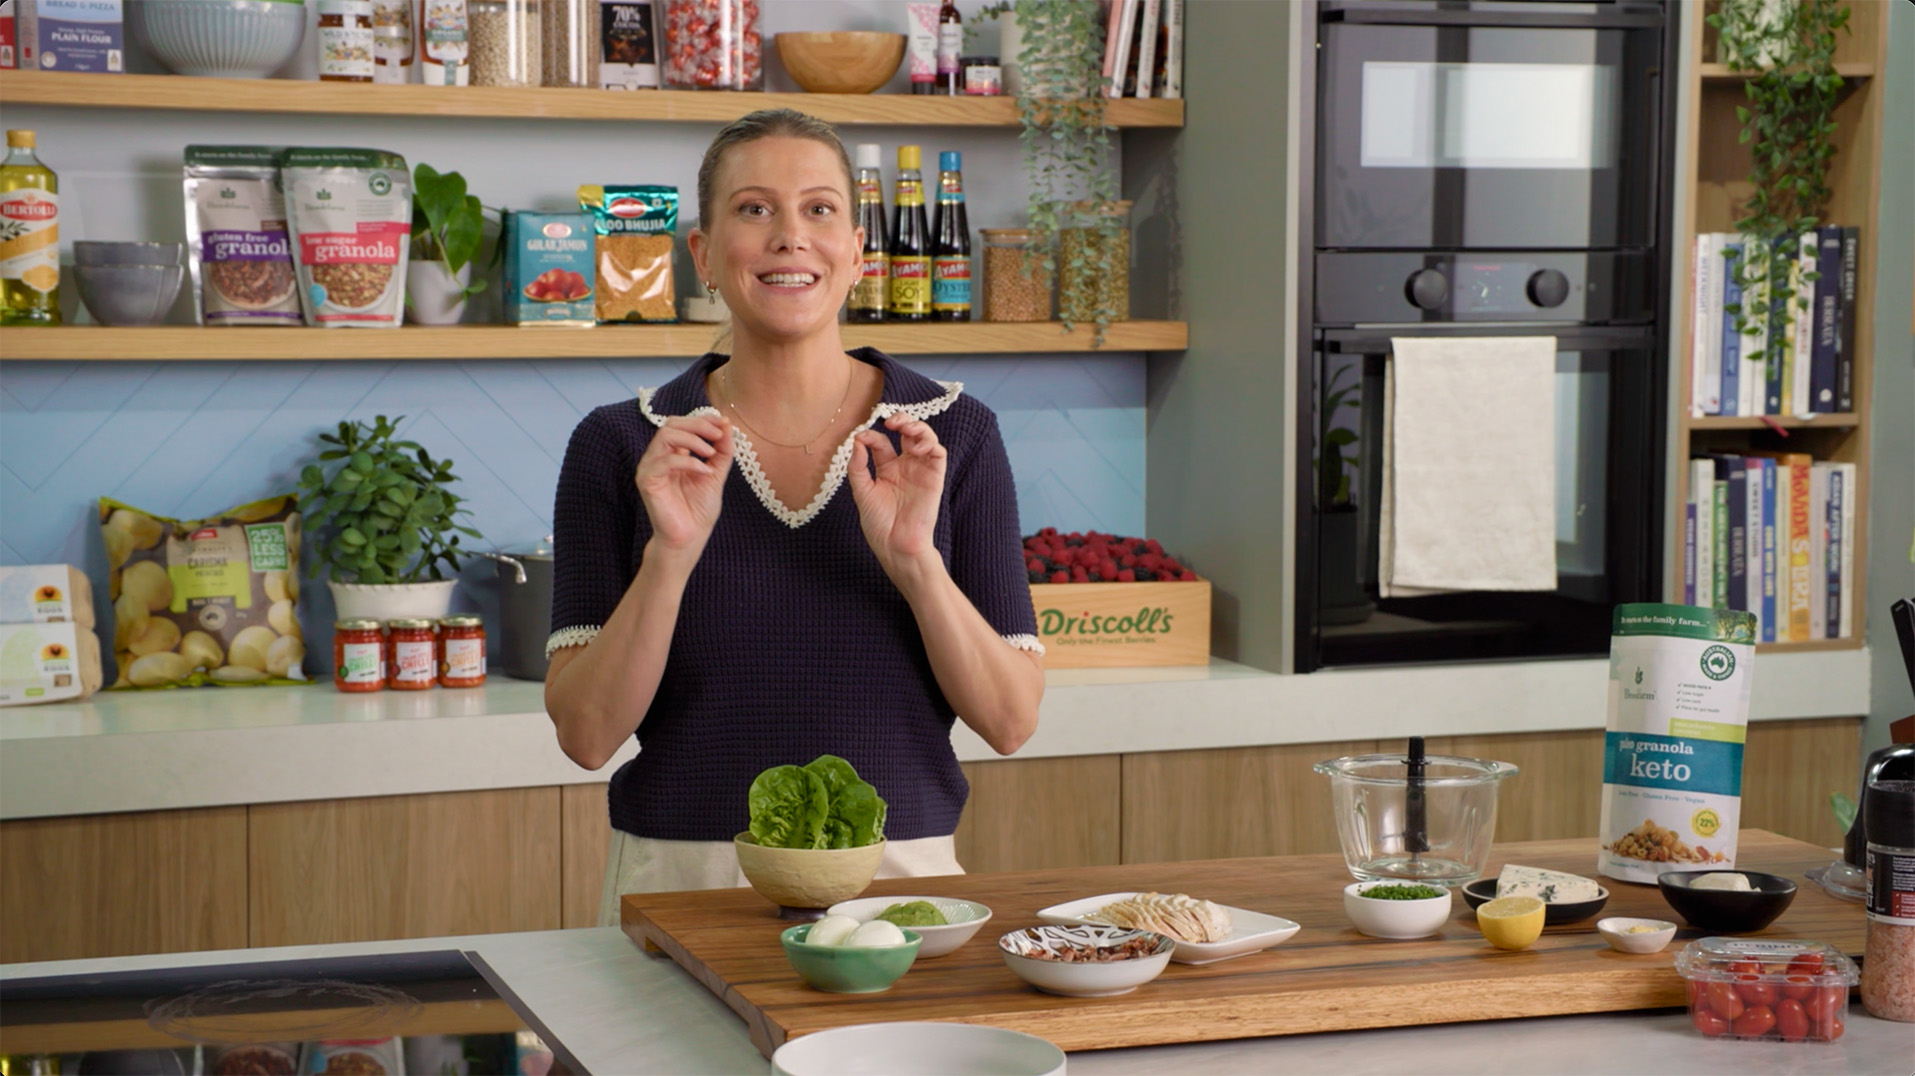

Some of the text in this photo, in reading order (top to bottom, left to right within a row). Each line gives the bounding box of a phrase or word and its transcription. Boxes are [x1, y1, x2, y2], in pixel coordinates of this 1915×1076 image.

[612, 5, 641, 22] 70%
[52, 32, 112, 44] PLAIN FLOUR
[3, 204, 56, 216] BERTOLLI
[625, 219, 665, 230] BHUJIA
[207, 232, 269, 244] gluten free
[305, 235, 357, 246] low sugar
[215, 238, 288, 260] granol
[315, 241, 395, 262] granola
[1846, 238, 1856, 268] SWEET
[895, 286, 923, 299] SOY
[1752, 482, 1760, 518] SWEET
[1830, 474, 1842, 572] ASIAN AFTER WORK
[251, 528, 284, 542] 25%
[253, 544, 285, 556] LESS
[1040, 607, 1174, 636] Driscoll's
[1653, 616, 1677, 625] family
[1056, 636, 1156, 646] Only the Finest Berries
[1702, 646, 1735, 663] AUSTRALIAN
[1637, 742, 1694, 755] granola
[1630, 753, 1691, 781] keto
[1642, 792, 1663, 800] Gluten
[1685, 796, 1705, 804] Vegan
[1700, 818, 1715, 828] 22%
